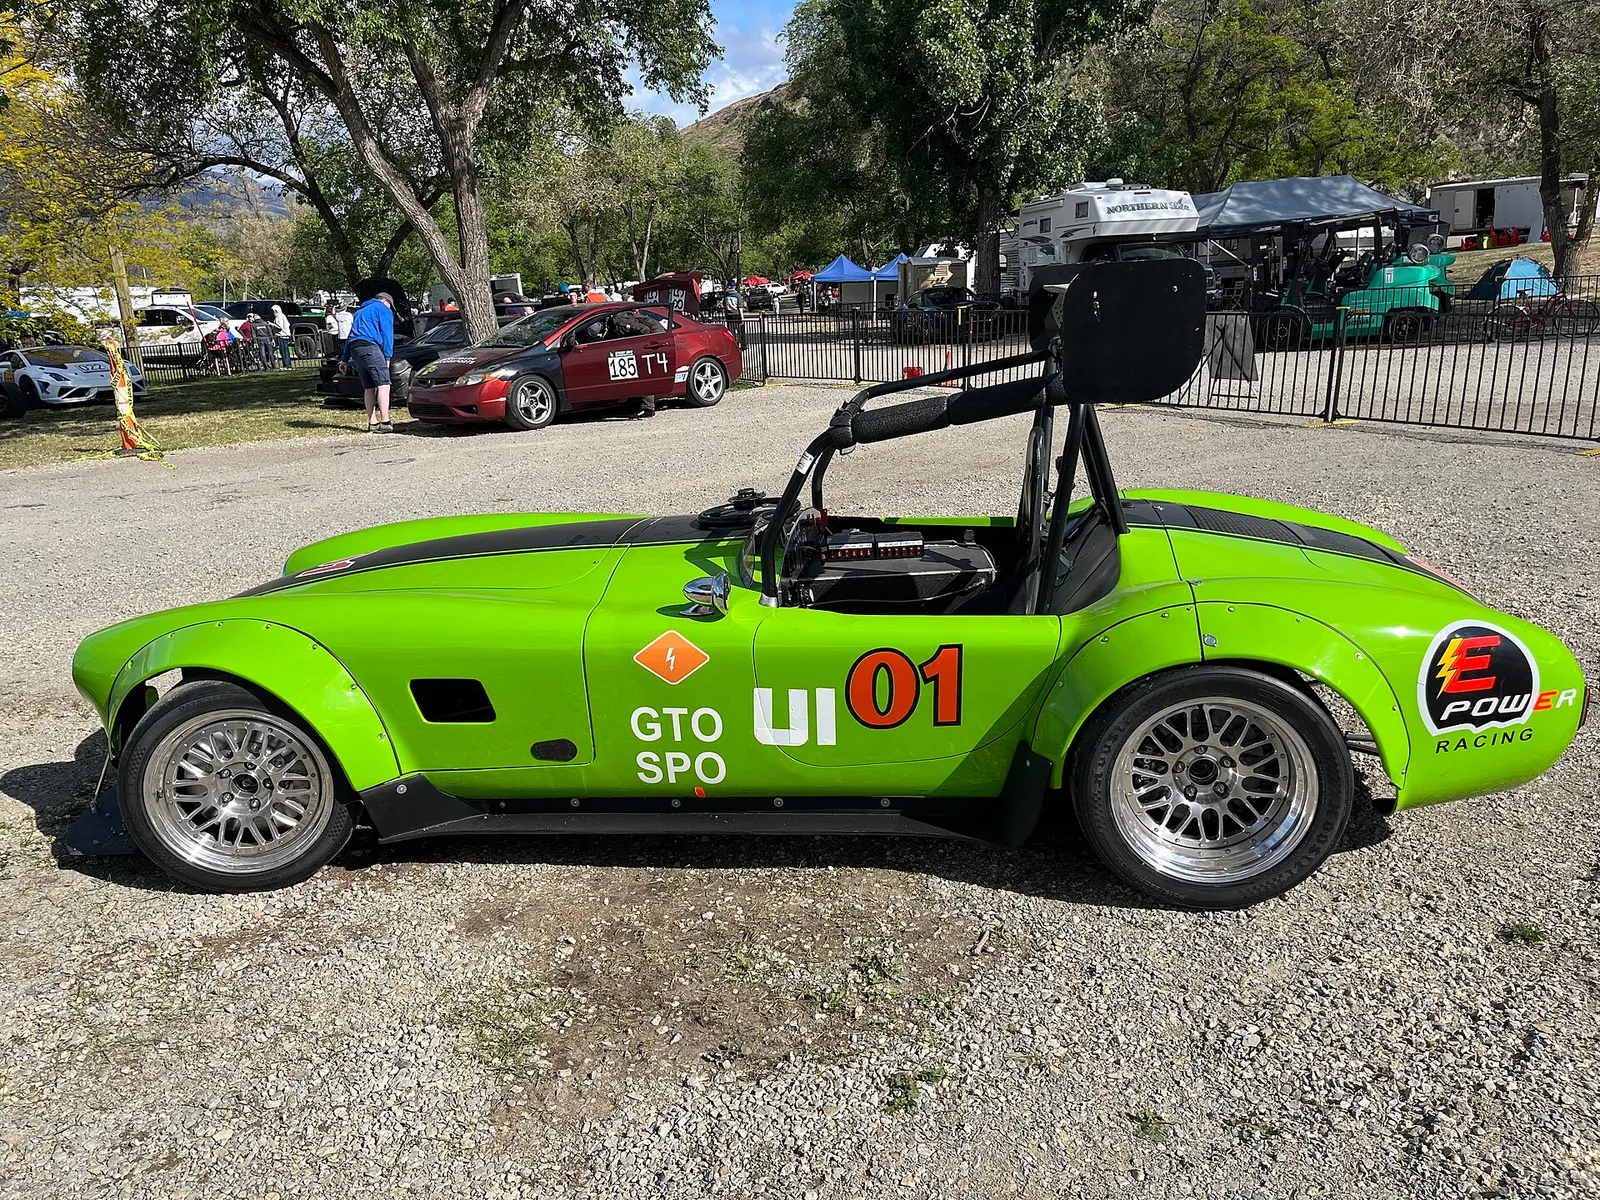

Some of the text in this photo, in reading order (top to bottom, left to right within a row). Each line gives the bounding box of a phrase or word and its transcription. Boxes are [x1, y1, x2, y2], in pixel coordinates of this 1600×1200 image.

[1106, 202, 1168, 214] NORTHERN
[610, 358, 636, 378] 185
[641, 352, 668, 374] T4
[845, 643, 963, 729] 01
[1440, 688, 1577, 721] POWER
[630, 706, 723, 742] GTO
[1436, 728, 1533, 754] RACING
[636, 751, 727, 784] SPO
